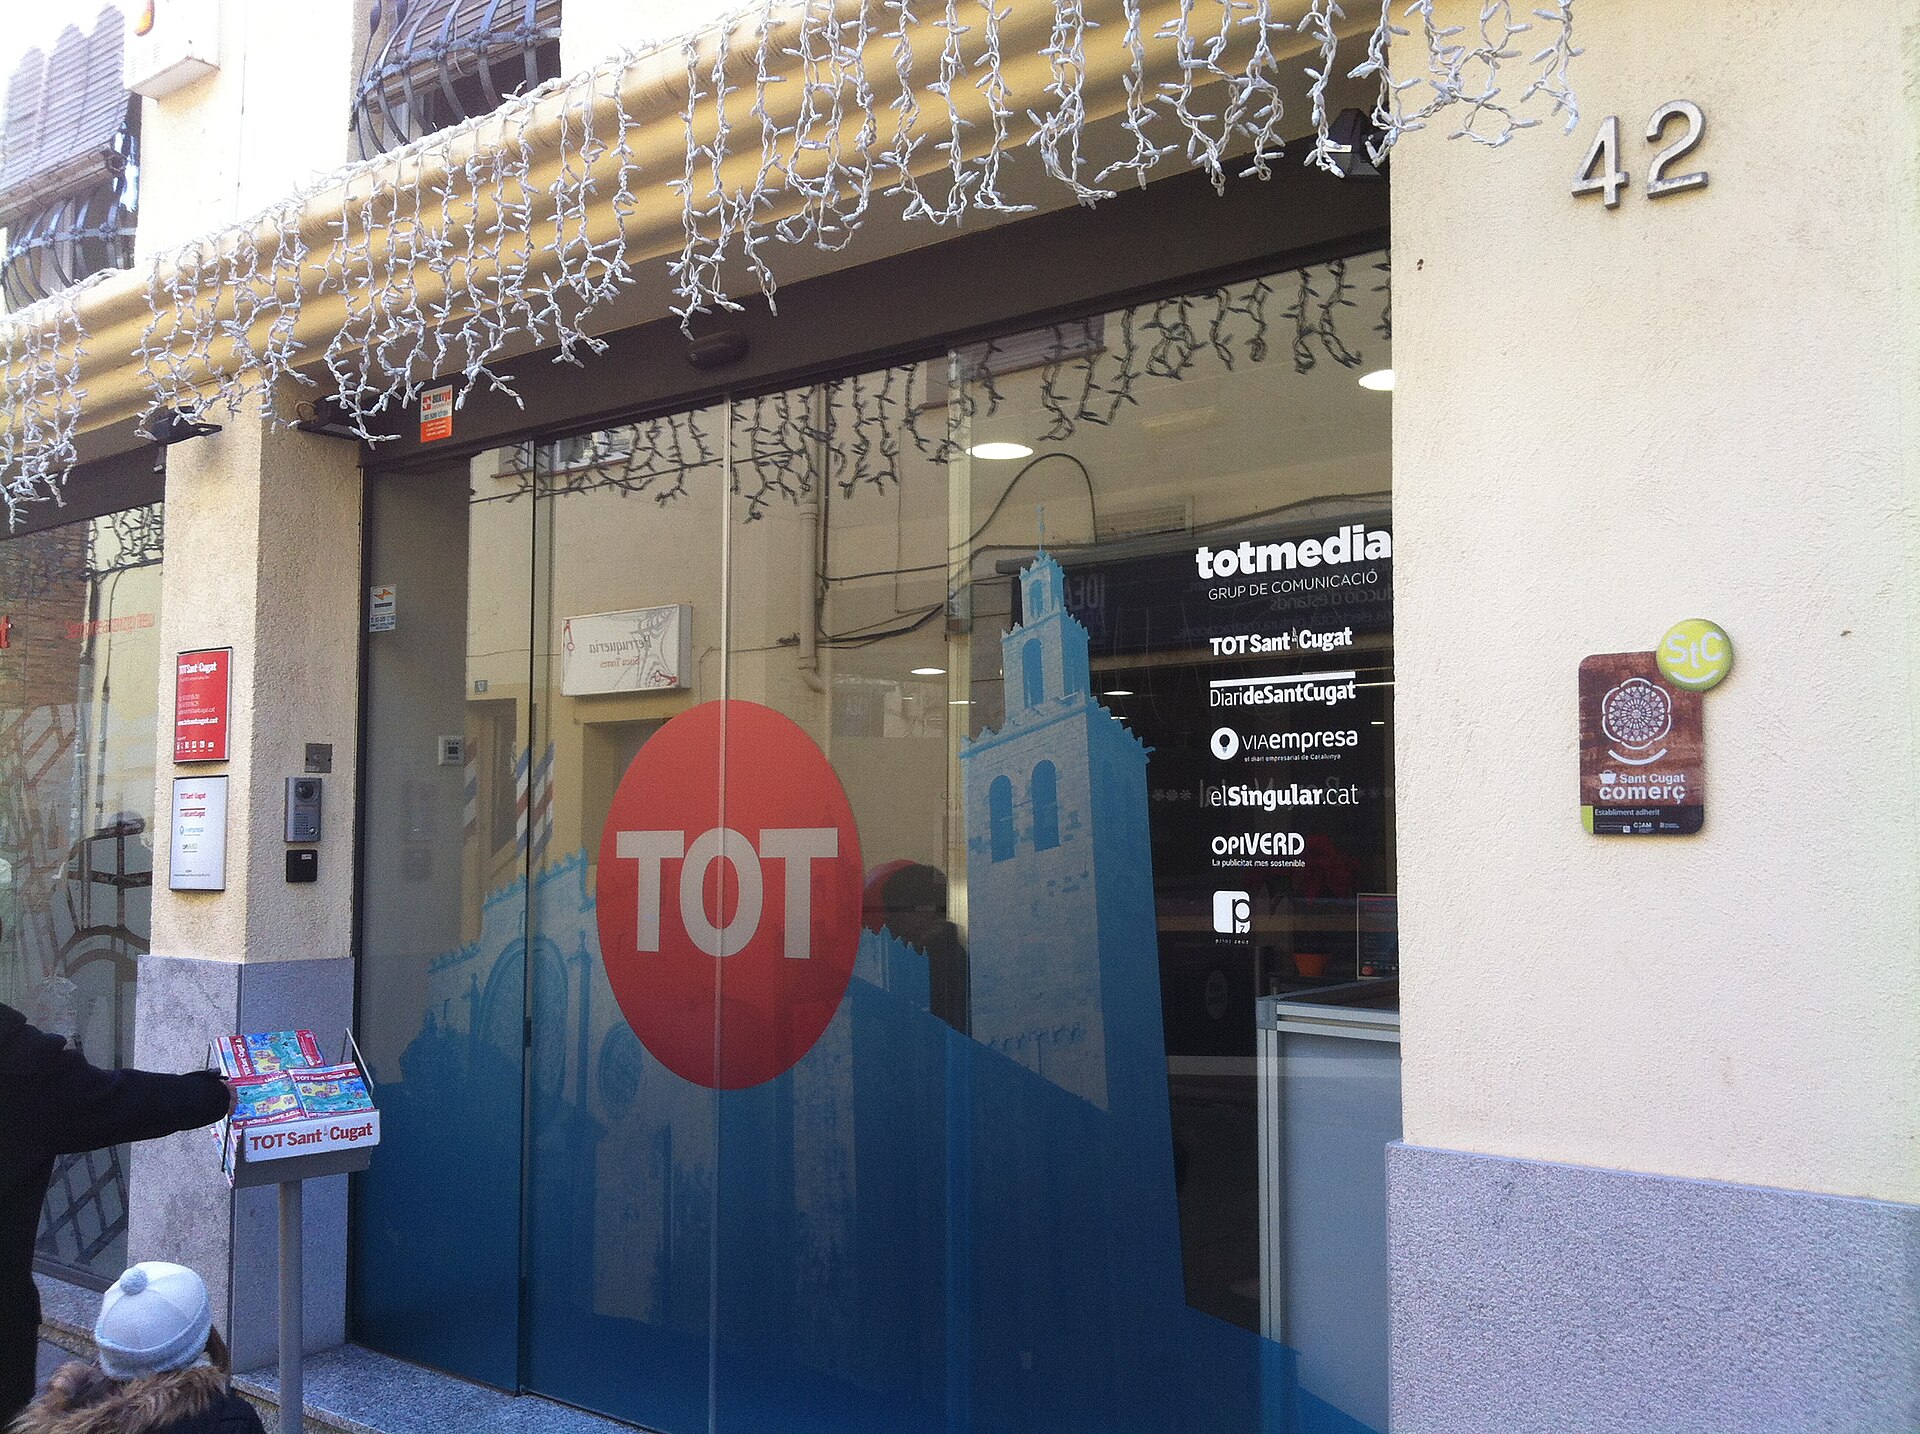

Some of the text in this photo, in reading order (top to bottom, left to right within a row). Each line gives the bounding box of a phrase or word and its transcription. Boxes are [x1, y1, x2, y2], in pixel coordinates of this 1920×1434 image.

[1571, 99, 1709, 209] 42
[1195, 524, 1392, 580] totmedia
[1208, 568, 1378, 601] GRUP DE COMUNICACIÓ
[1299, 627, 1353, 652] Cugat
[1210, 681, 1356, 707] DiarideSantCugat
[1241, 729, 1359, 753] VIAempresa
[1619, 772, 1685, 786] Sant Cugat
[1210, 784, 1359, 811] elSingular.cat
[1598, 785, 1686, 803] comerç
[1595, 808, 1660, 816] Establiment adherit
[1222, 859, 1253, 868] publicitat
[1270, 859, 1306, 868] sostenible
[616, 827, 838, 959] TOT
[250, 1123, 373, 1151] TOT Sant Cugat
